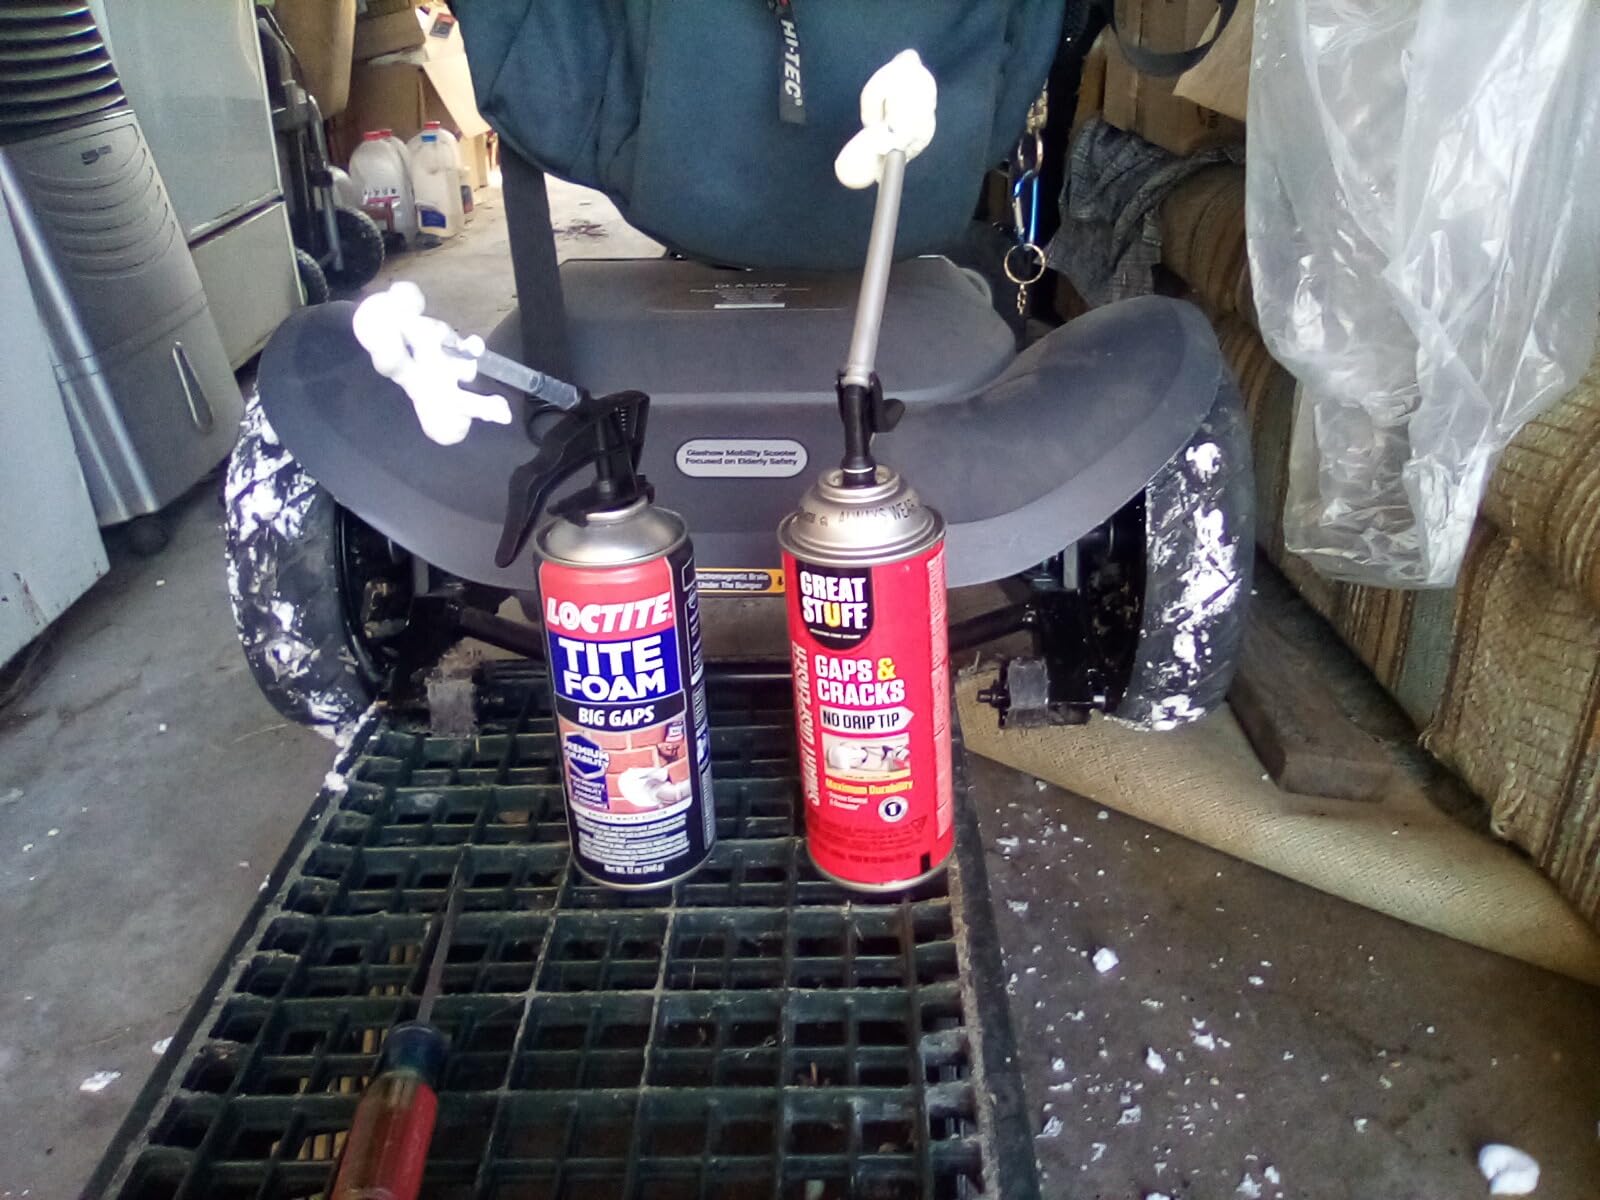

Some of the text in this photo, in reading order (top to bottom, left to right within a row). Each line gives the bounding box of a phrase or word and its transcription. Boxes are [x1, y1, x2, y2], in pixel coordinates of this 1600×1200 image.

[781, 19, 800, 99] HI-TEC
[725, 449, 760, 458] Mobility
[738, 458, 767, 466] Elderly
[769, 458, 797, 466] Safety
[800, 570, 866, 603] GREAT
[546, 592, 671, 634] LOCTITE
[802, 596, 868, 630] STUFF
[558, 635, 664, 676] TITE
[814, 654, 897, 683] GAPS &
[563, 667, 667, 702] FOAM
[816, 678, 905, 707] CRACKS
[577, 704, 655, 727] BIG GAPS
[822, 709, 900, 730] NO DRIP TIP
